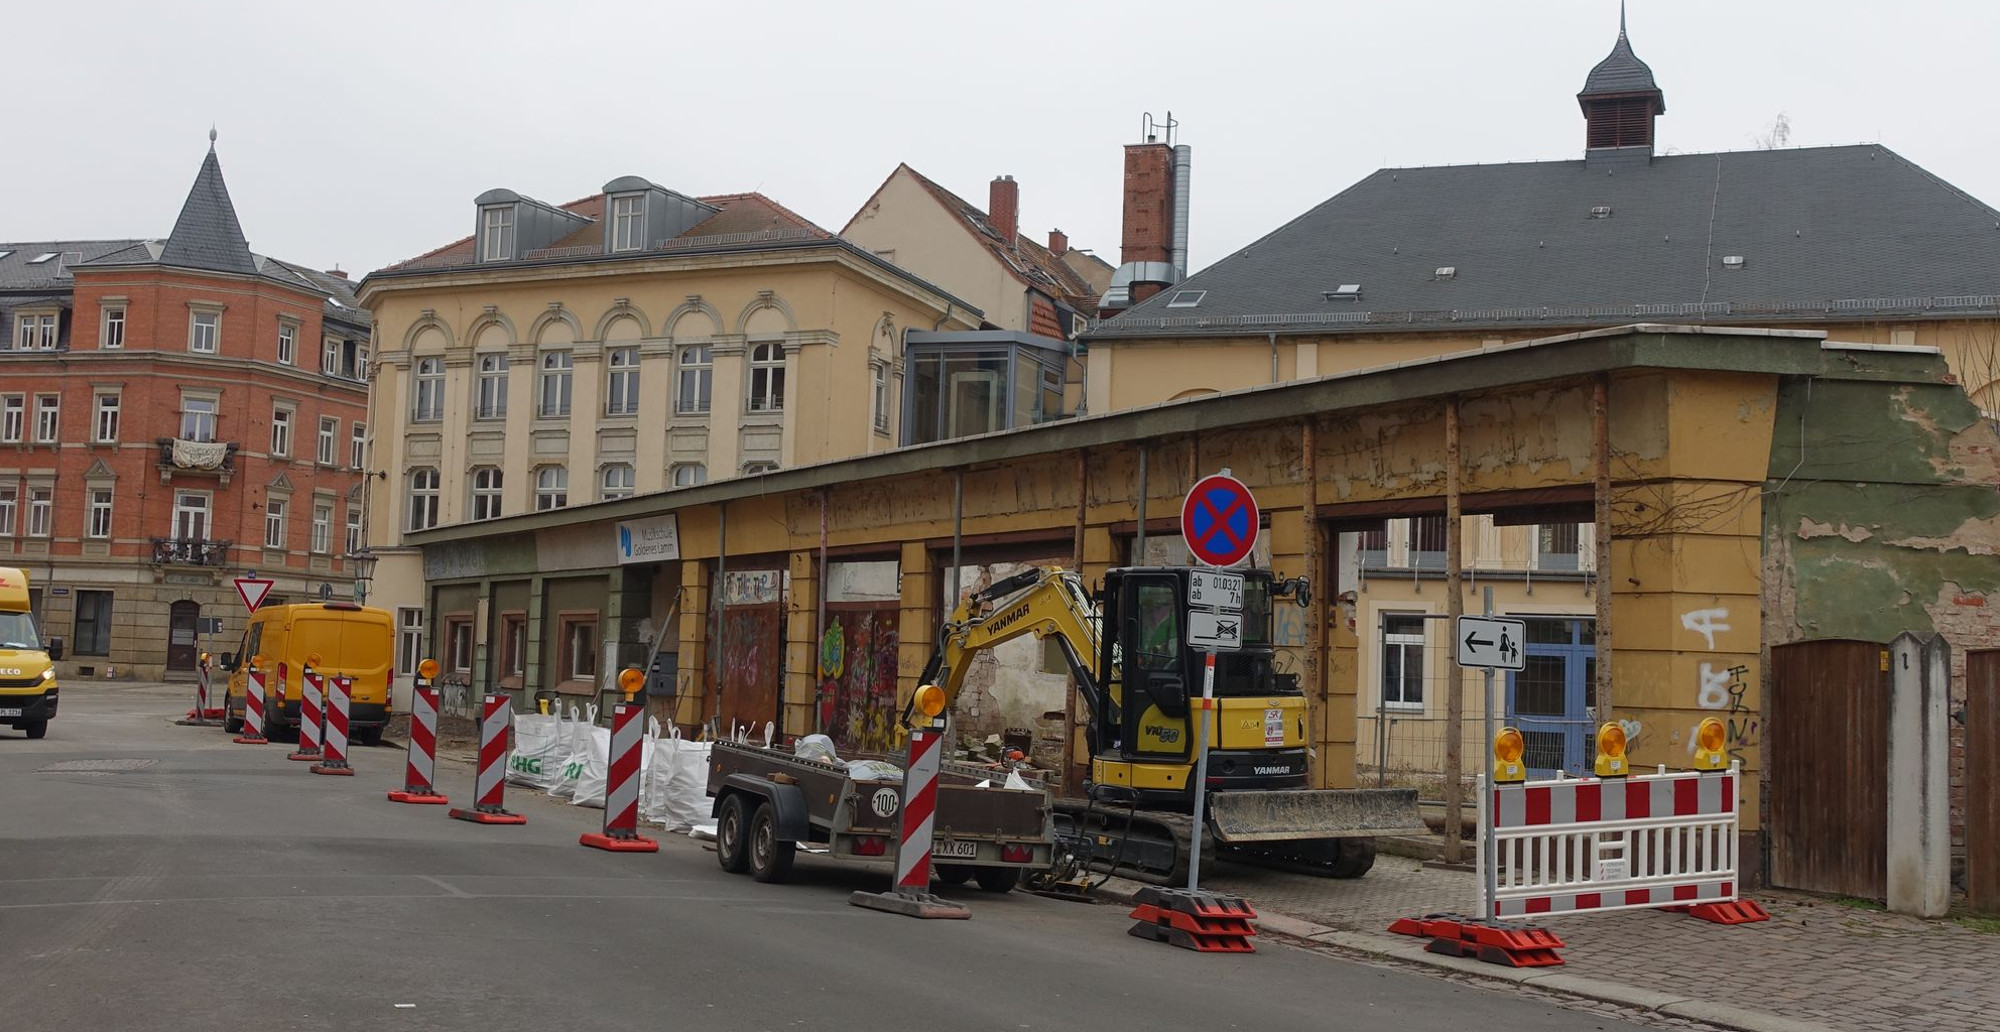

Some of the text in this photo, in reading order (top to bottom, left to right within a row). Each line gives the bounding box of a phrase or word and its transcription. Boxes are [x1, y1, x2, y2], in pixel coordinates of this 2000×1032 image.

[641, 526, 673, 541] Musikschule
[634, 543, 674, 556] Goldenes Lamm
[1192, 575, 1241, 592] ab 01.03.21
[1191, 588, 1202, 600] ab
[986, 603, 1030, 636] YANMAR
[1253, 765, 1290, 775] YANMAR
[874, 794, 896, 813] 100
[957, 842, 975, 856] 601
